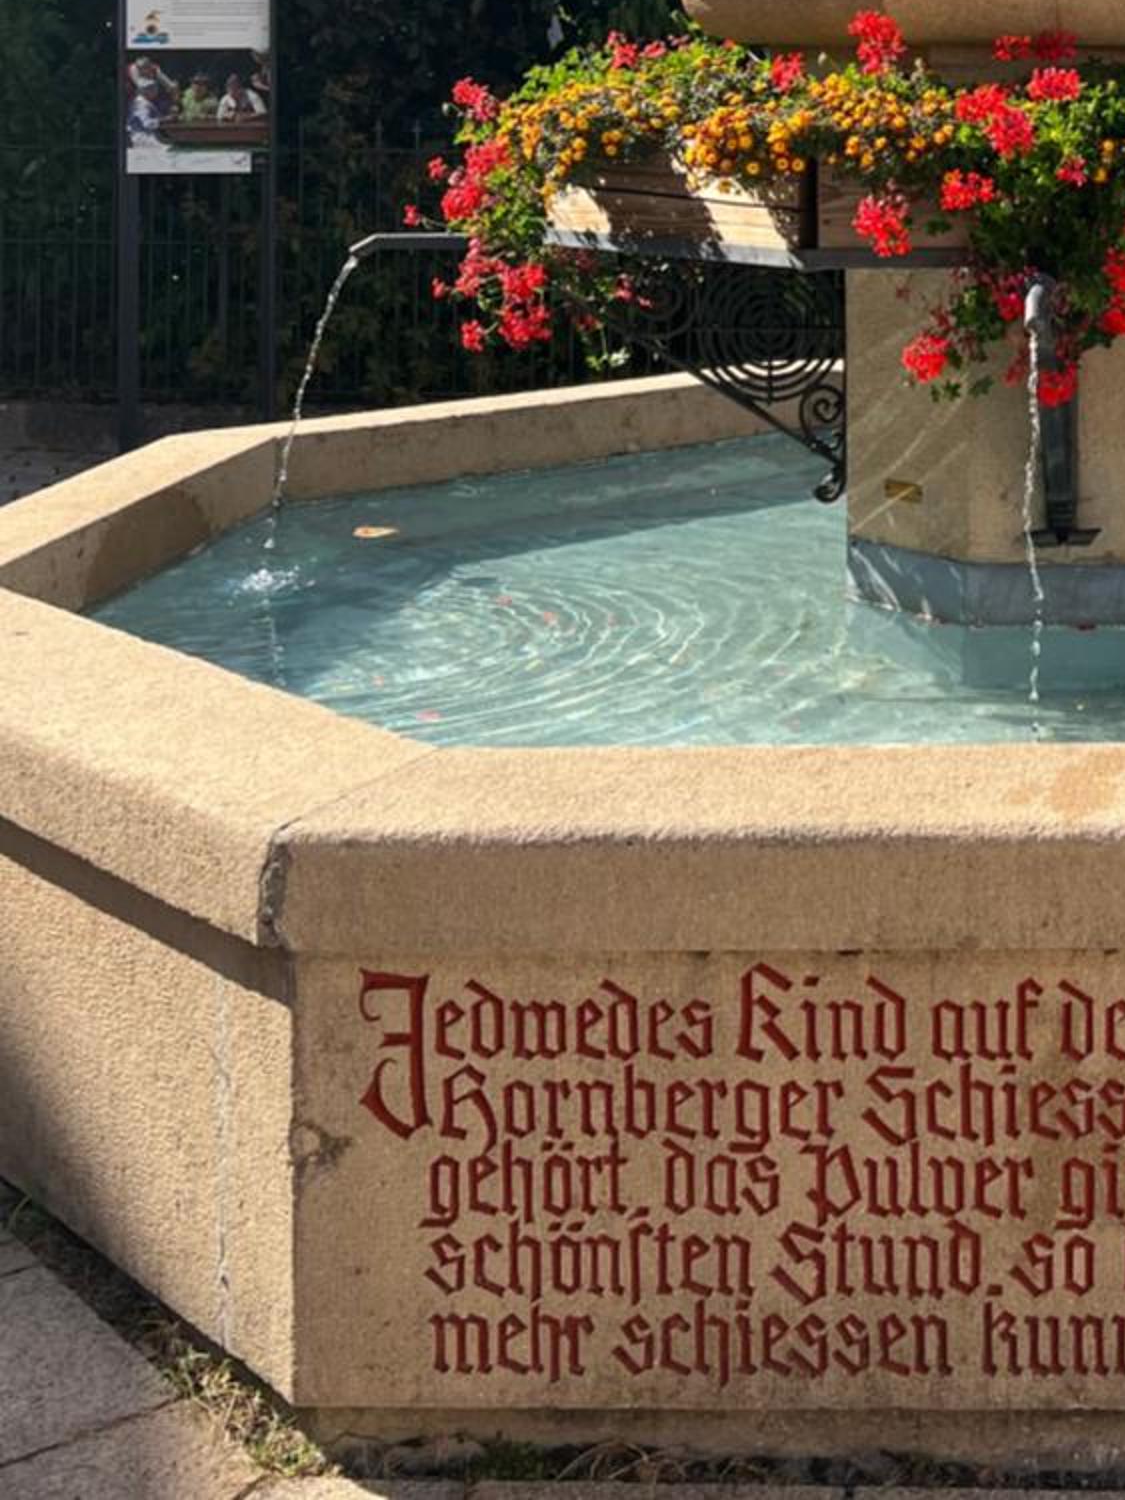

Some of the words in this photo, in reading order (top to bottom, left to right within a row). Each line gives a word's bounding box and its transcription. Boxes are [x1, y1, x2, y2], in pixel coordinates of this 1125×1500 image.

[361, 965, 712, 1139] Jedwedes
[736, 963, 906, 1062] Kind
[932, 977, 1043, 1062] auf
[441, 1064, 843, 1156] Hornberger
[661, 1139, 779, 1218] das
[799, 1141, 1034, 1228] Pulver
[1011, 1232, 1094, 1298] so
[430, 1300, 593, 1382] mehr
[613, 1299, 951, 1387] schiessen
